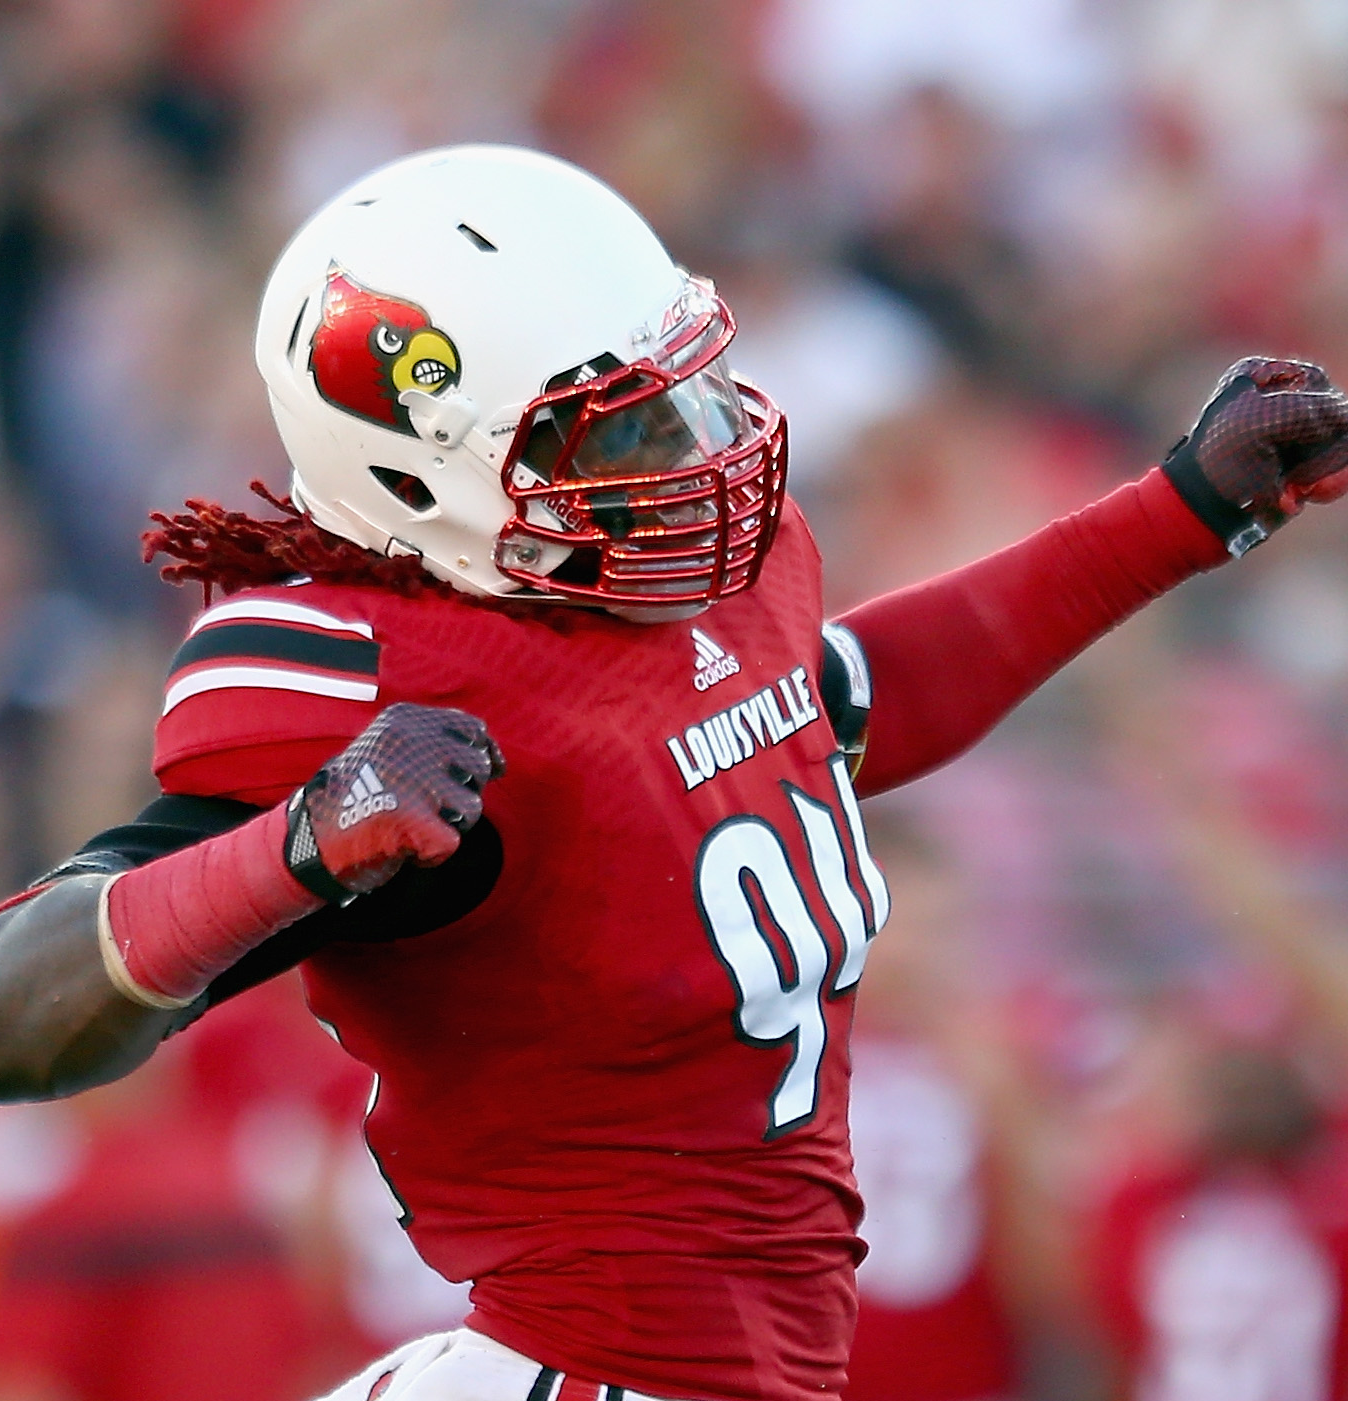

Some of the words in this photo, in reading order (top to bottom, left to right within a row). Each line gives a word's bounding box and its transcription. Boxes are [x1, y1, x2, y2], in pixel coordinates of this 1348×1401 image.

[693, 654, 742, 692] adidas
[665, 666, 820, 791] LOUISVILLE
[338, 792, 399, 831] adidas
[696, 752, 891, 1142] 94
